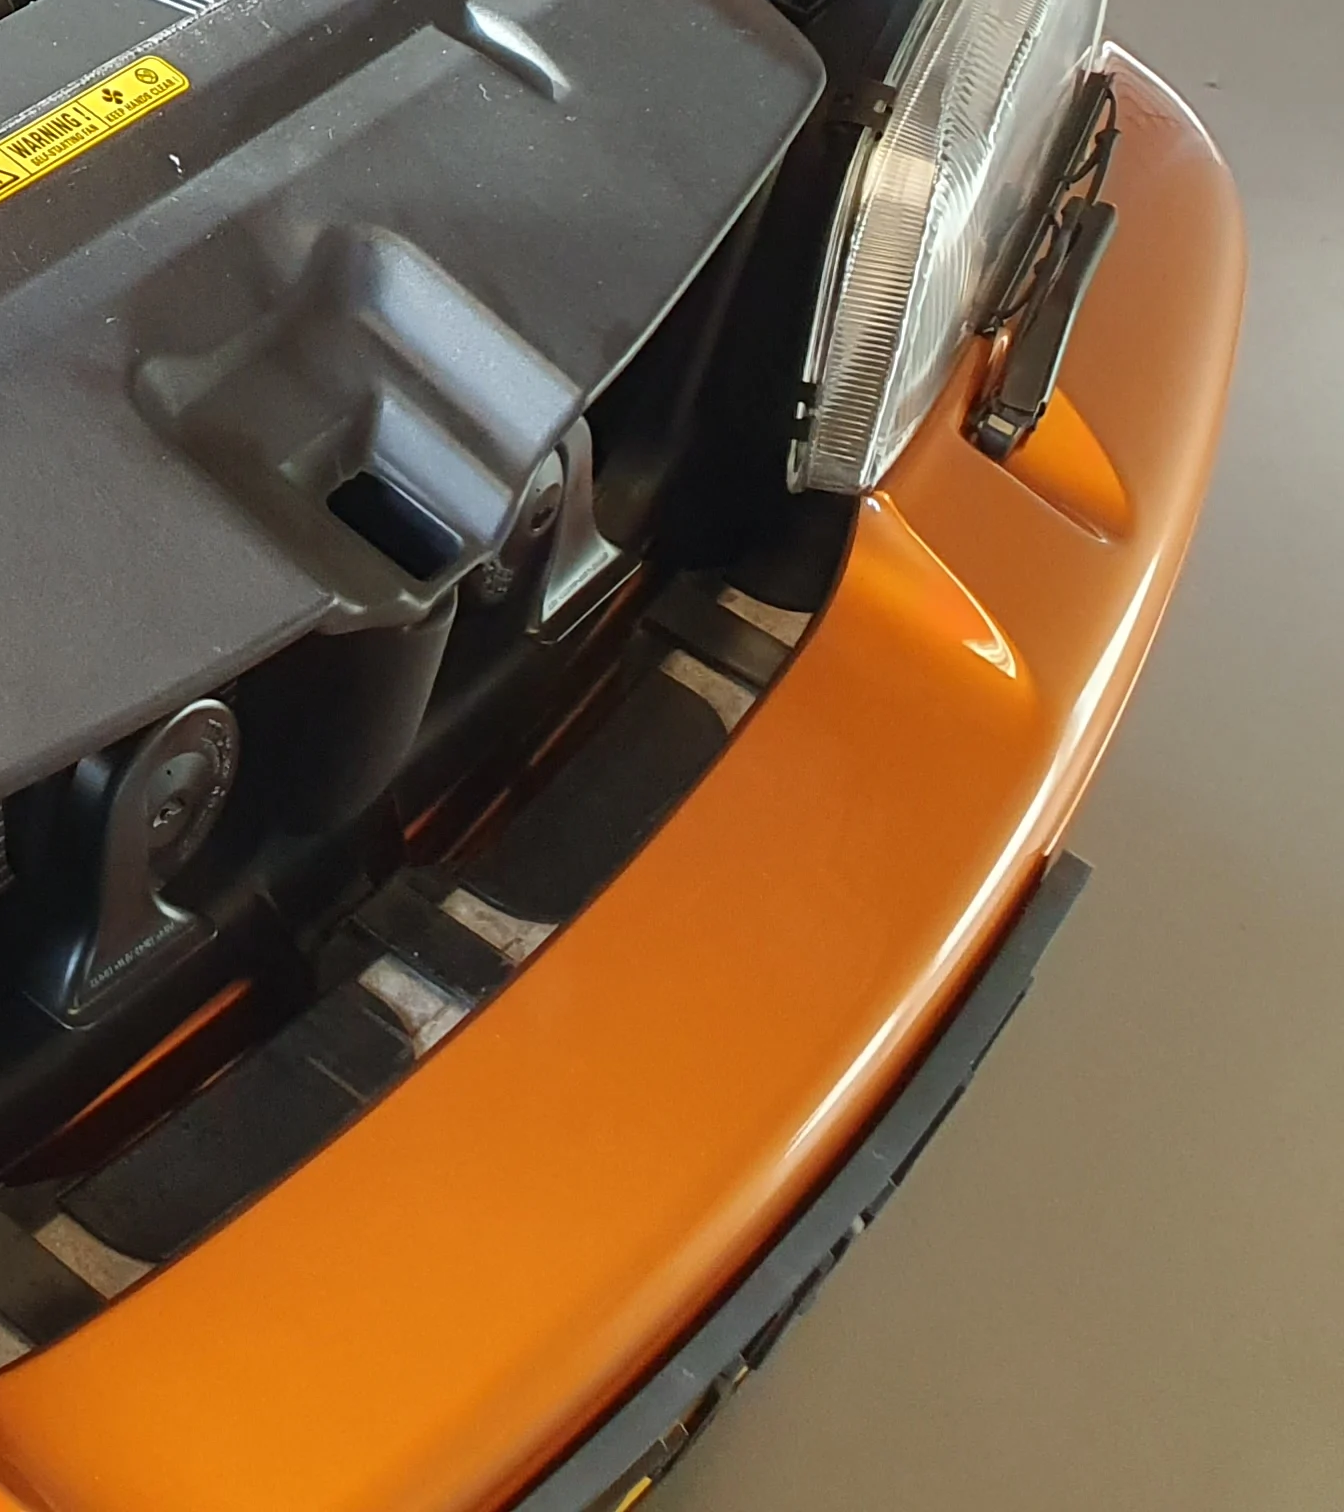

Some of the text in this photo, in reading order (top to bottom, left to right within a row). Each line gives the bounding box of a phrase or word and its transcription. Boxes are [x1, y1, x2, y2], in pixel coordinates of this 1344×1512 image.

[104, 108, 126, 123] KEEP
[124, 92, 153, 112] HANDS
[149, 79, 176, 96] CLEAR
[7, 112, 82, 159] WARNING
[30, 123, 100, 167] SELF-STARTING FAN
